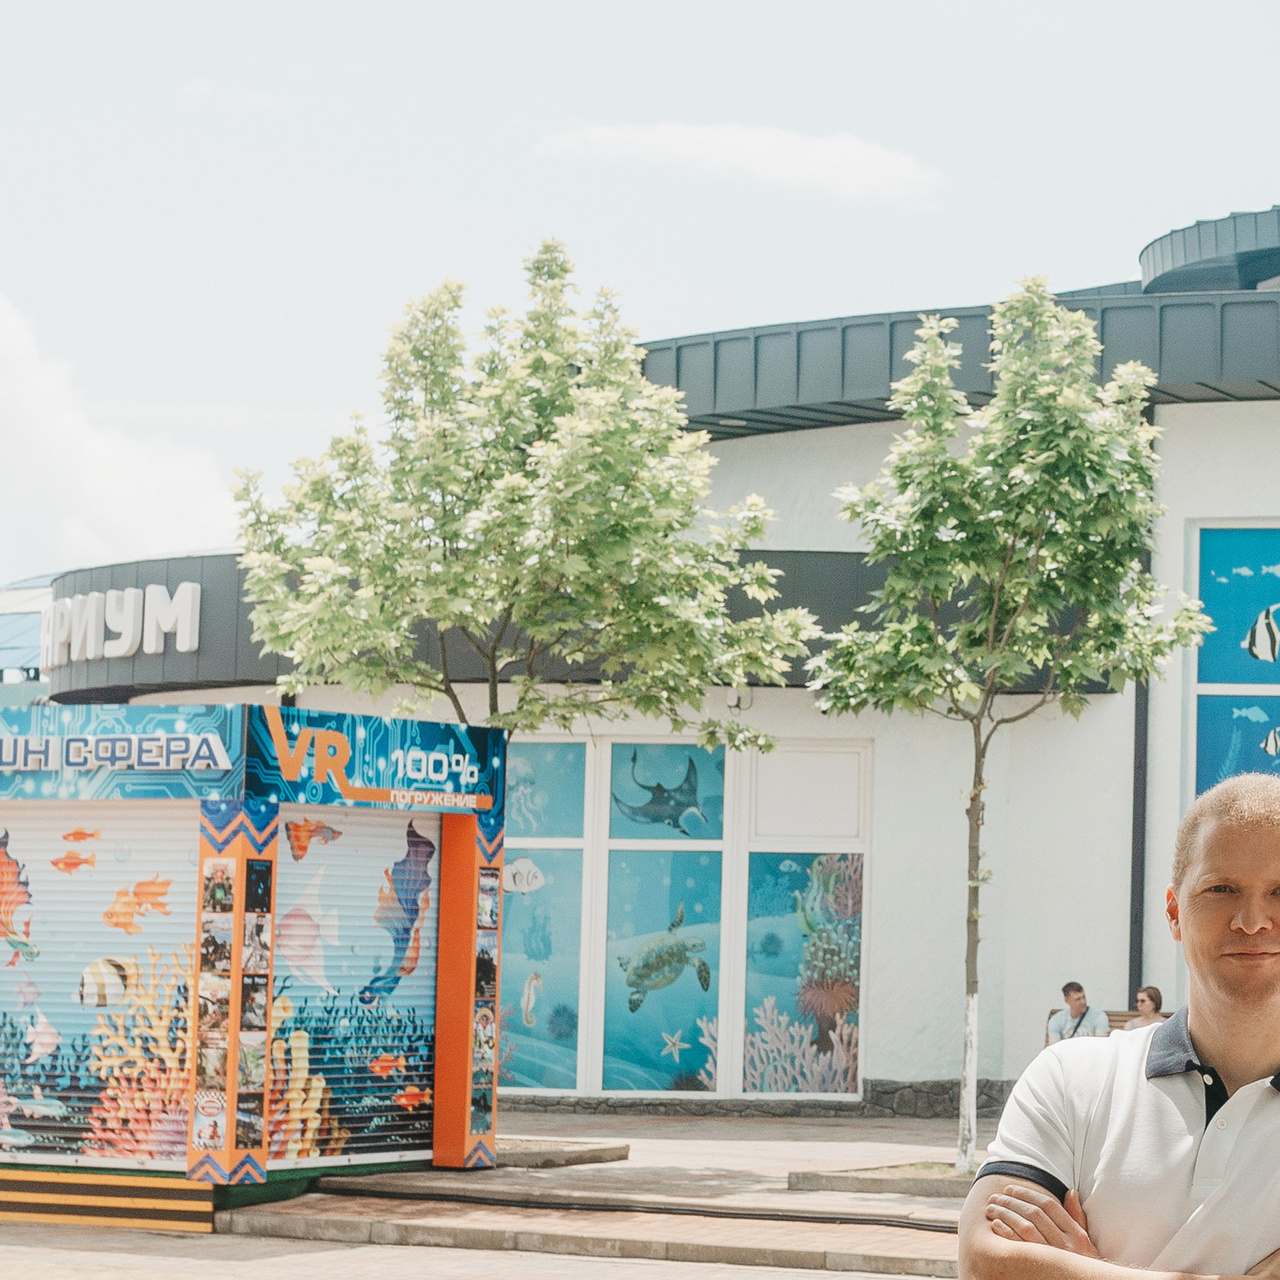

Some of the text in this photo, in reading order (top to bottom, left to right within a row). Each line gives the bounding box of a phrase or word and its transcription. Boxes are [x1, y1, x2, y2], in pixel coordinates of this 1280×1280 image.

[64, 735, 226, 770] СФЕРА
[263, 704, 352, 798] VR
[391, 749, 479, 784] 100%
[390, 789, 478, 809] ПОГРУЖЕНИЕ
